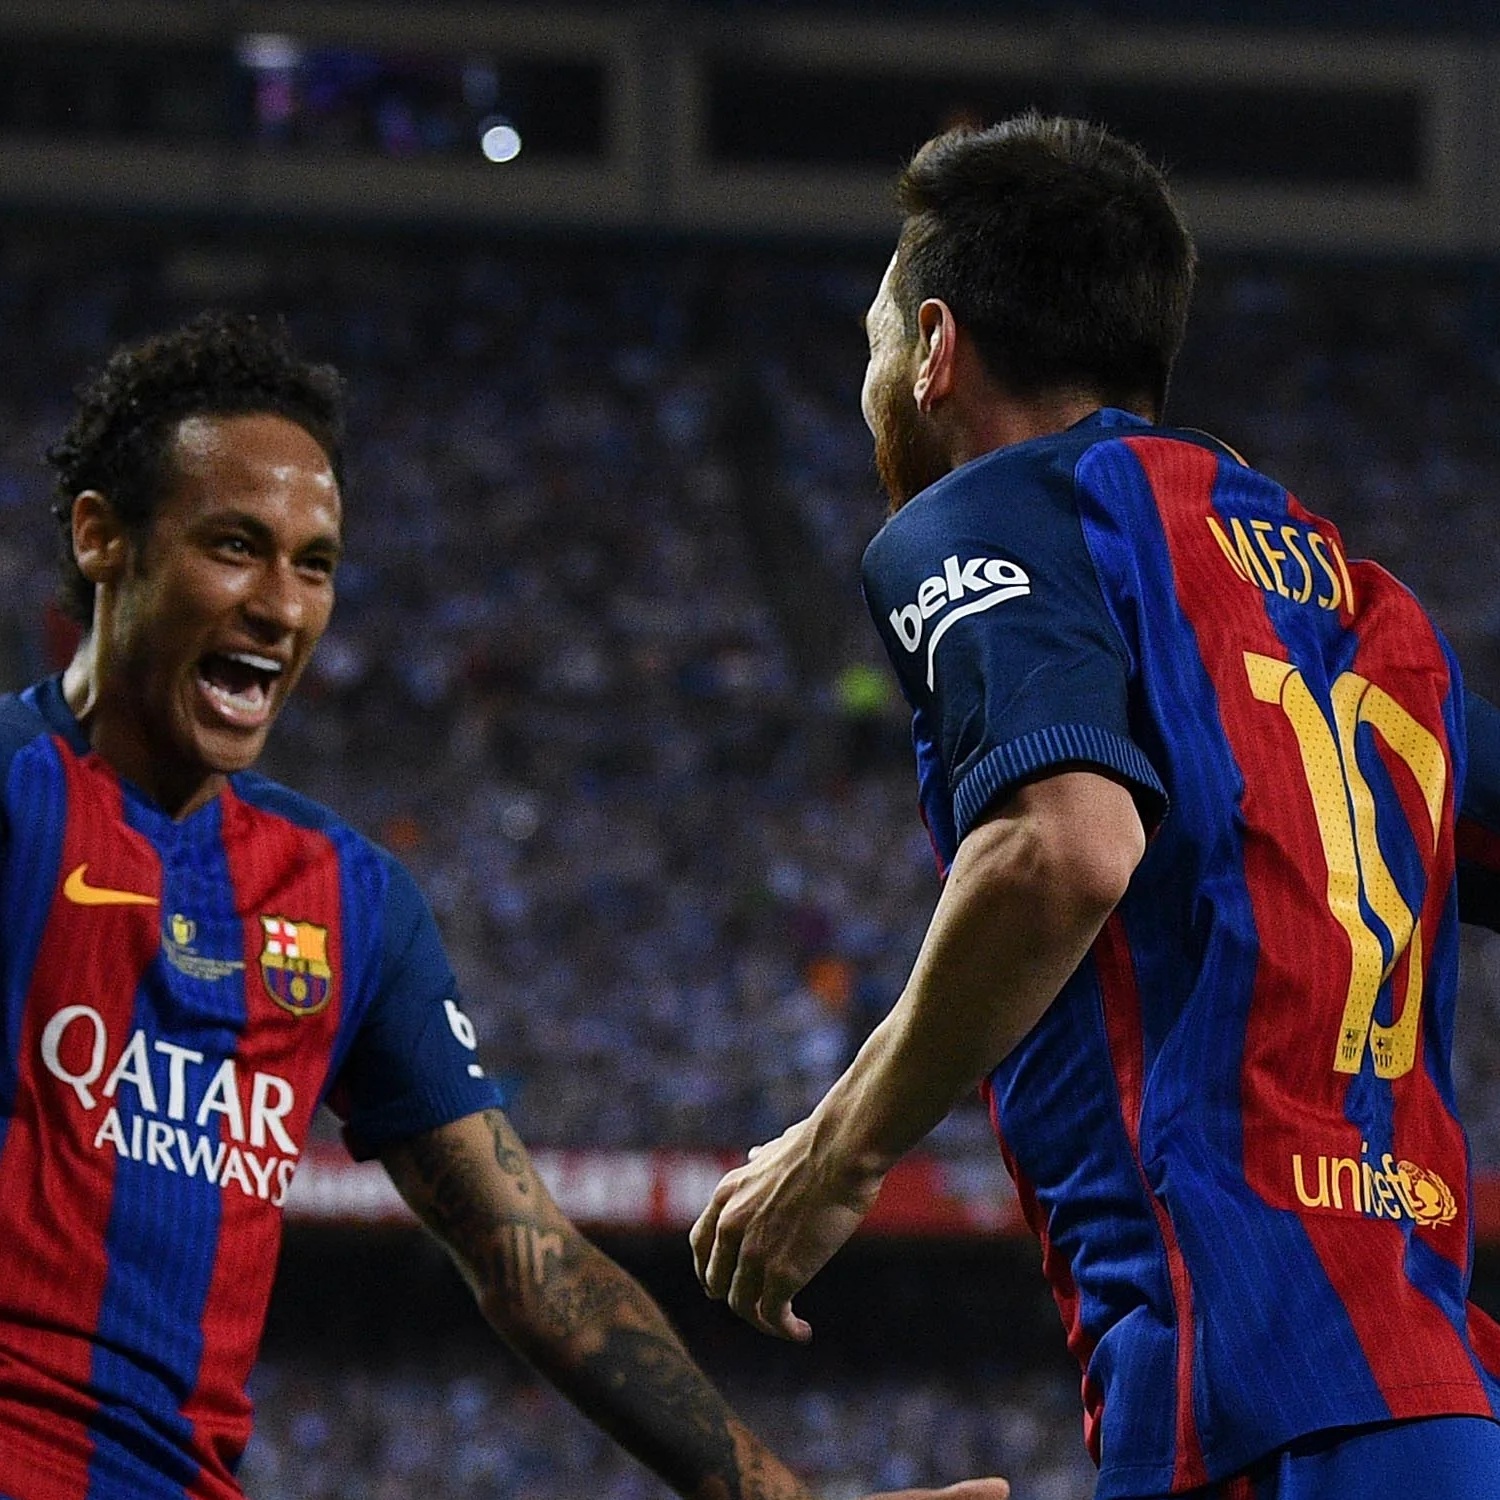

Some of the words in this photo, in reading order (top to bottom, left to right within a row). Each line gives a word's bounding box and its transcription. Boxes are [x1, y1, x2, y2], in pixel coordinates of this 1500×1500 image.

[889, 555, 1031, 653] beko
[1206, 515, 1356, 616] MESSI
[1242, 650, 1447, 1079] 10
[41, 1004, 300, 1156] QATAR
[93, 1107, 297, 1208] AIRWAYS
[1292, 1141, 1417, 1221] unicef
